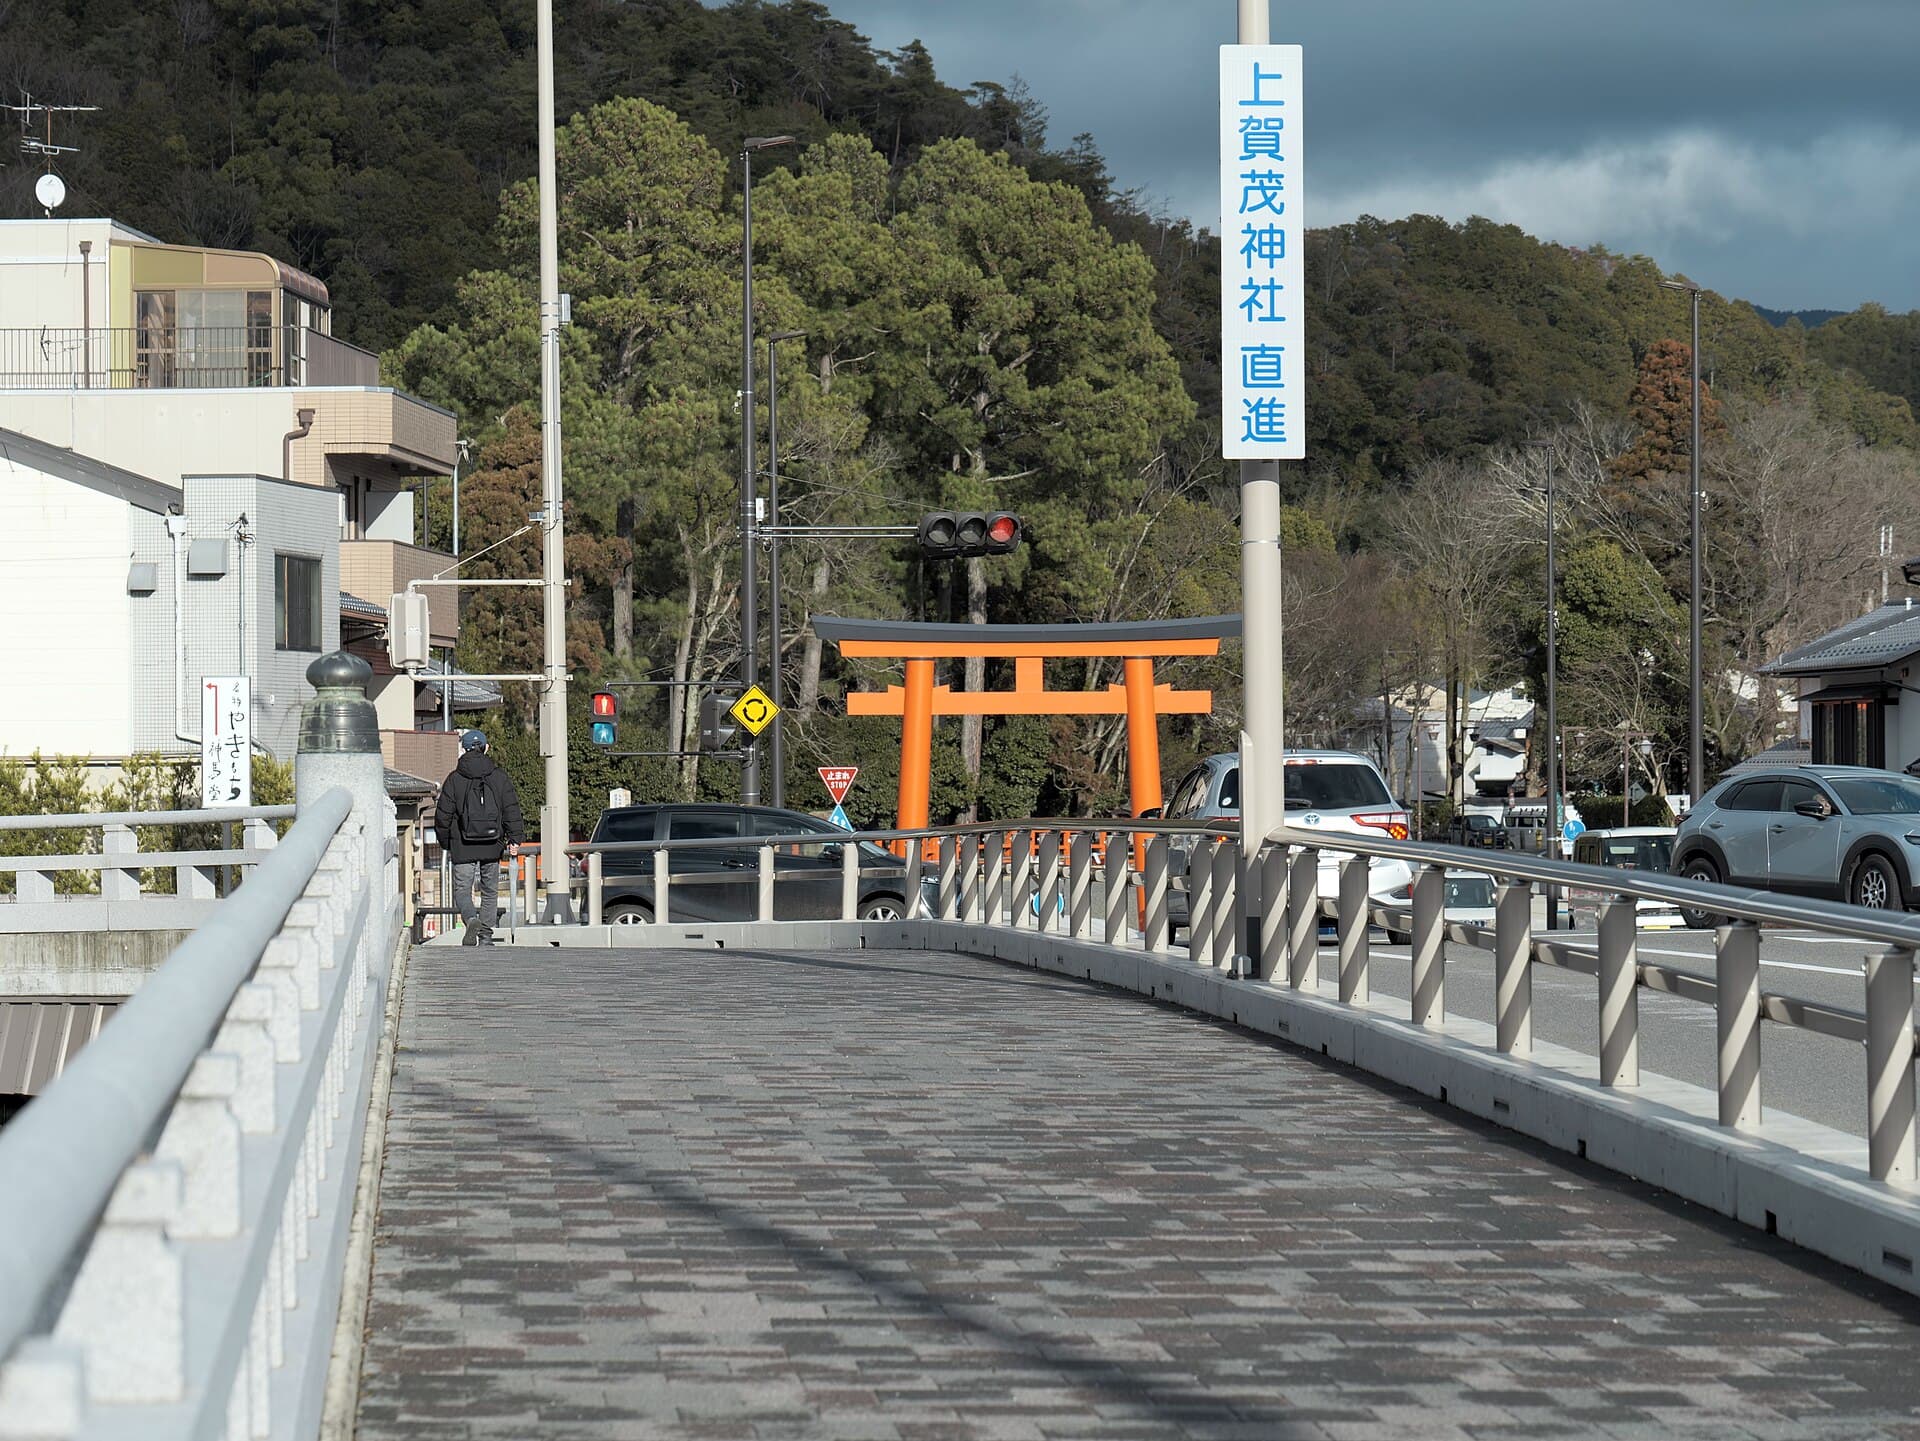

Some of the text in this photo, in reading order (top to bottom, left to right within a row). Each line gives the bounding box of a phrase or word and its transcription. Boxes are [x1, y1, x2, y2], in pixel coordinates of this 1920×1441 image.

[1238, 61, 1287, 443] 上賀茂神社 直進
[827, 771, 850, 779] 止まれ
[831, 781, 847, 789] STOP
